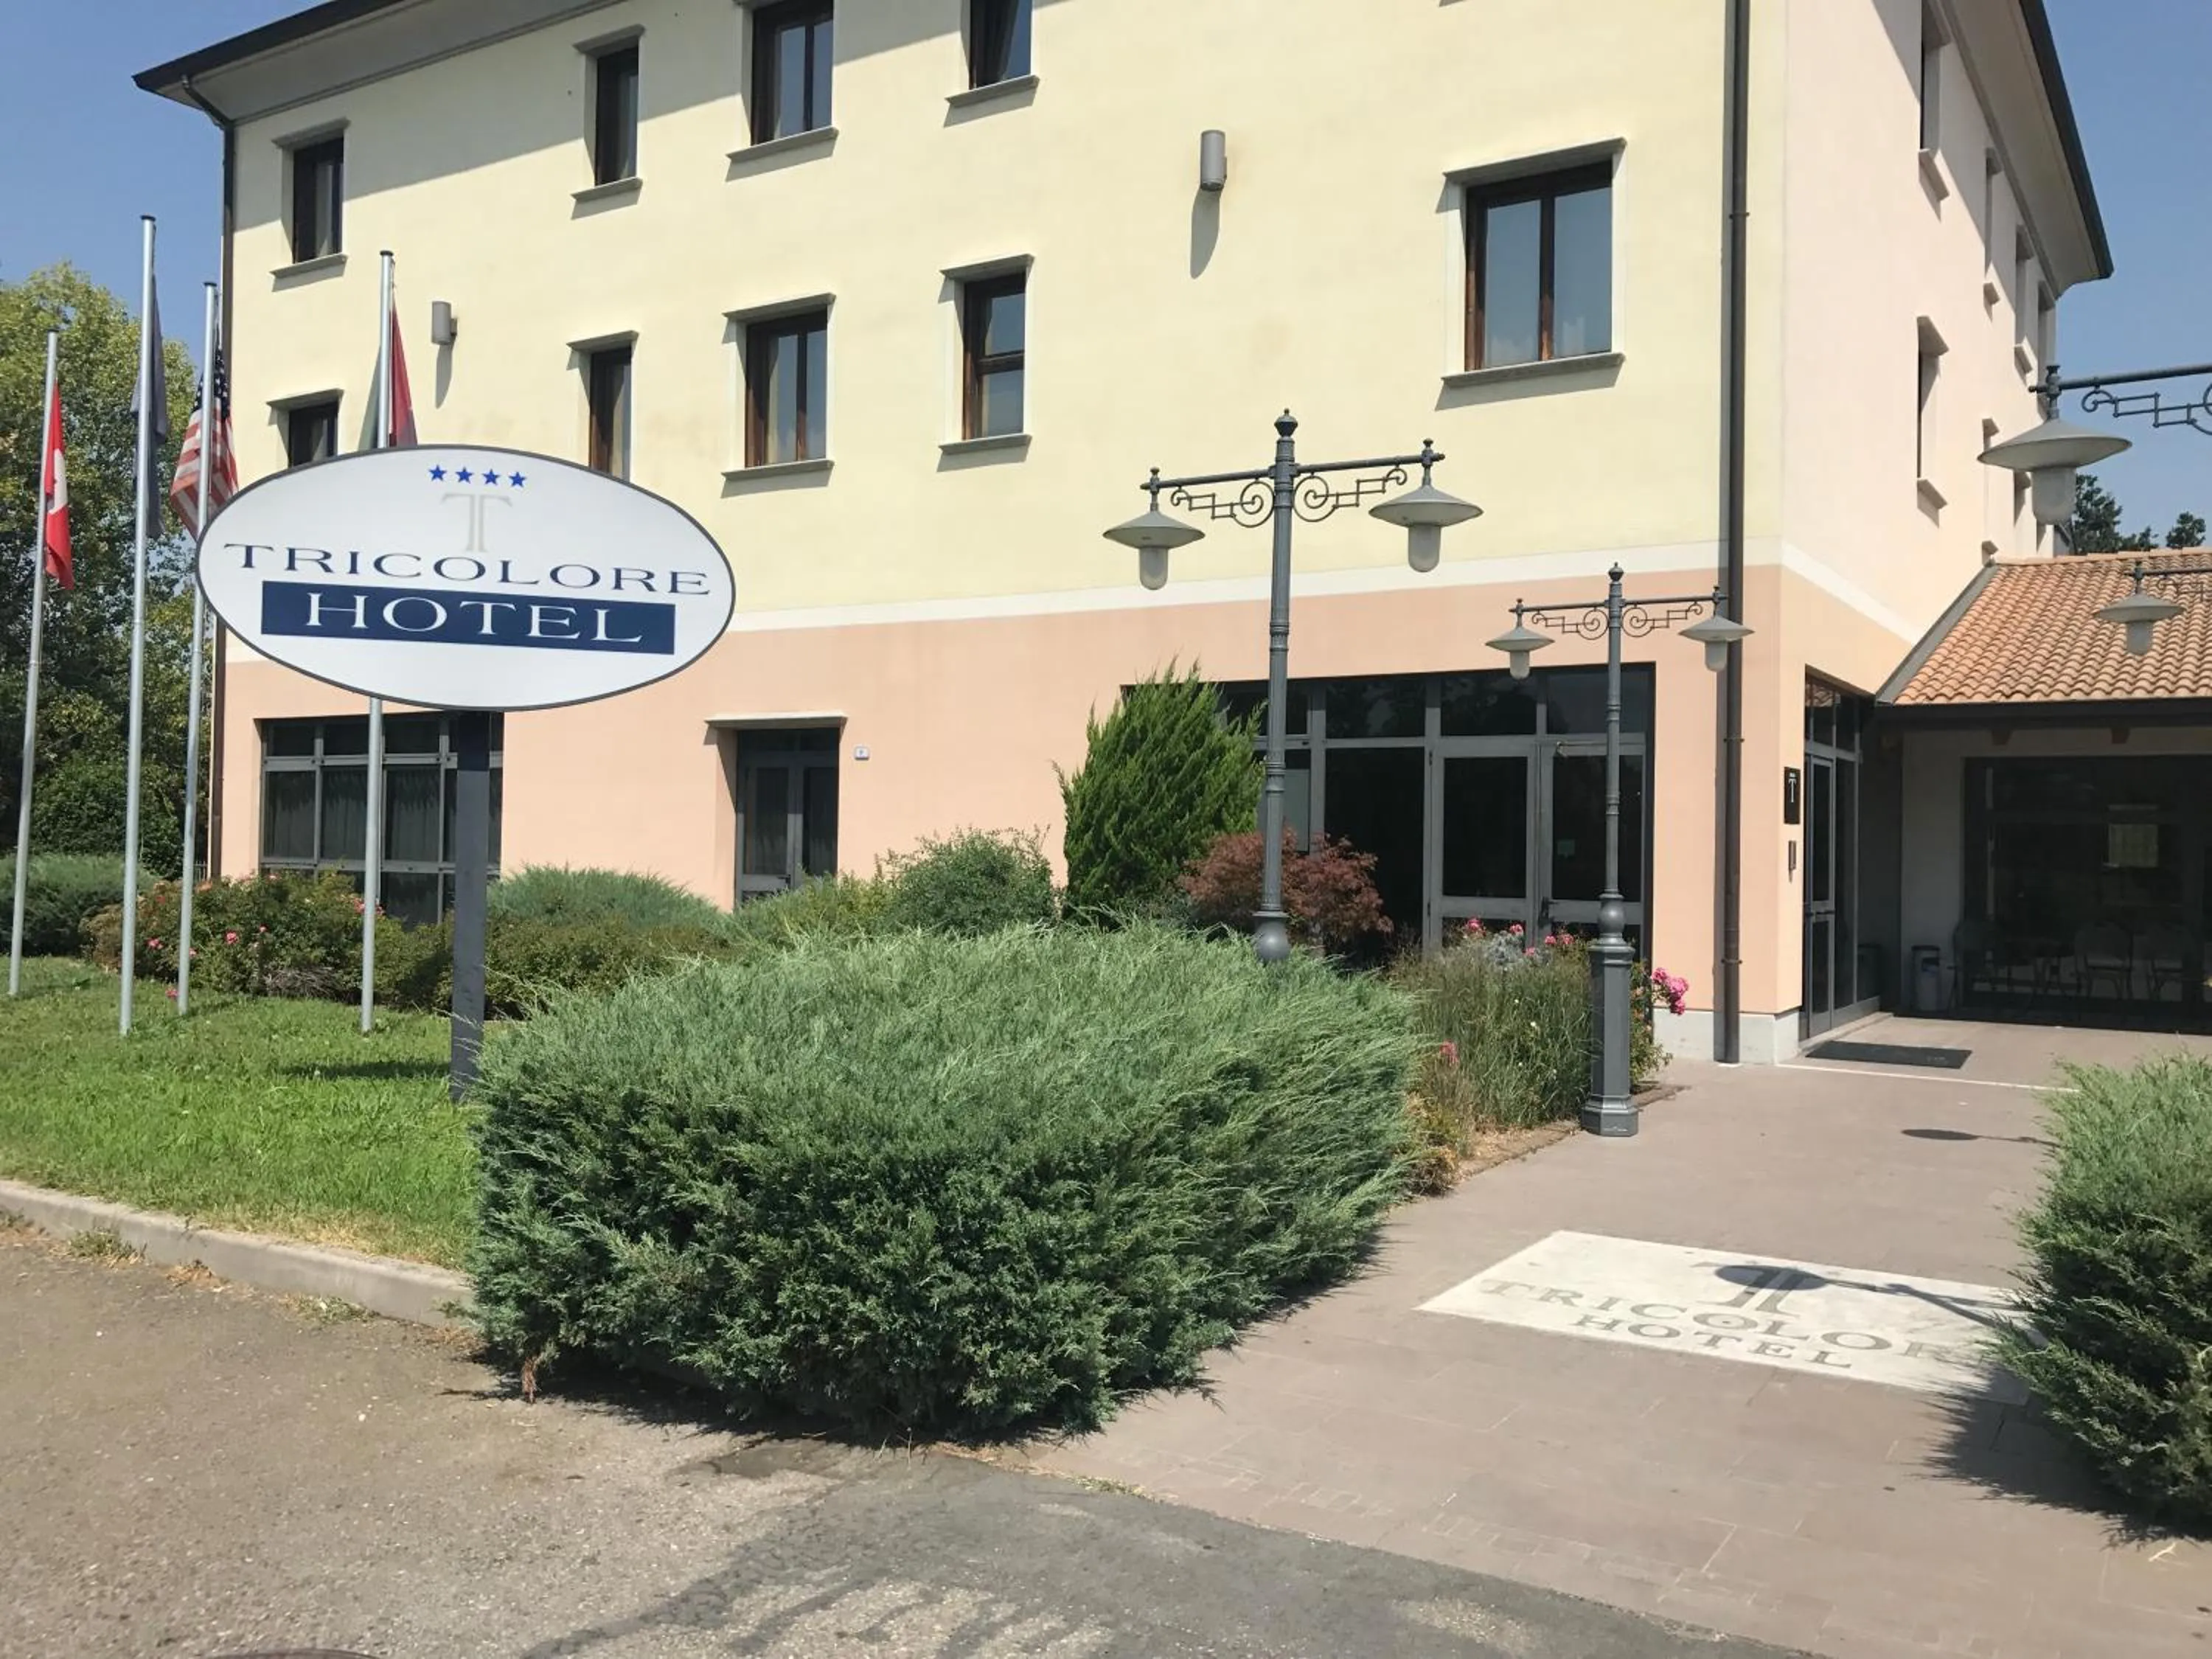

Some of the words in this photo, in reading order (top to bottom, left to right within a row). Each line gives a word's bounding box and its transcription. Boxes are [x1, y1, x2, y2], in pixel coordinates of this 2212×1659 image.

[440, 492, 513, 553] T
[223, 543, 710, 596] TRICOLORE
[305, 592, 641, 643] HOTEL
[1480, 1279, 1989, 1368] TRICOLOR
[1569, 1315, 1852, 1368] HOTEL
